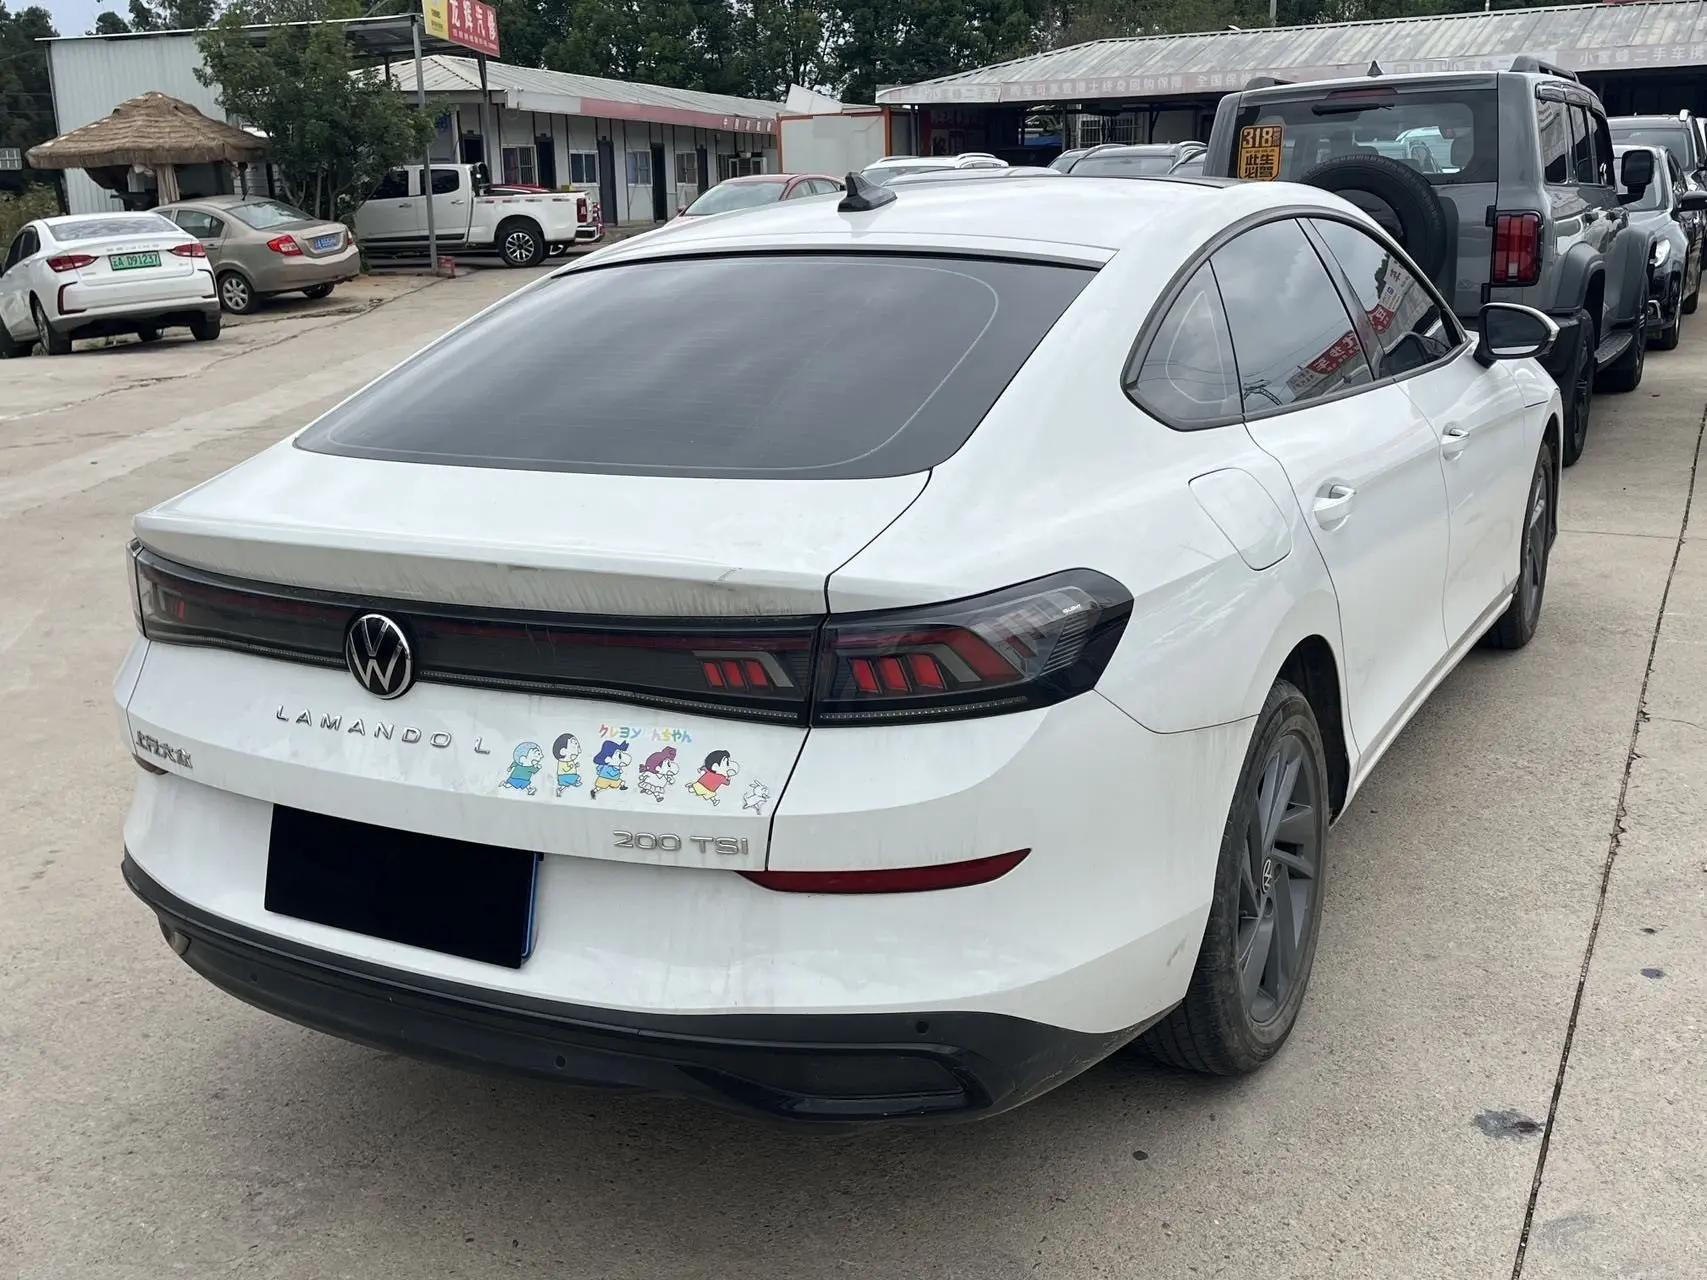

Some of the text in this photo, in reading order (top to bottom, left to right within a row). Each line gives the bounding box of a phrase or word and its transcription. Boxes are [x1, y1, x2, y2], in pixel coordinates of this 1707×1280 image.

[1242, 127, 1274, 148] 318
[1245, 153, 1275, 166] 此生
[276, 705, 490, 754] LAMANDO L
[613, 830, 749, 855] 200 TSI
